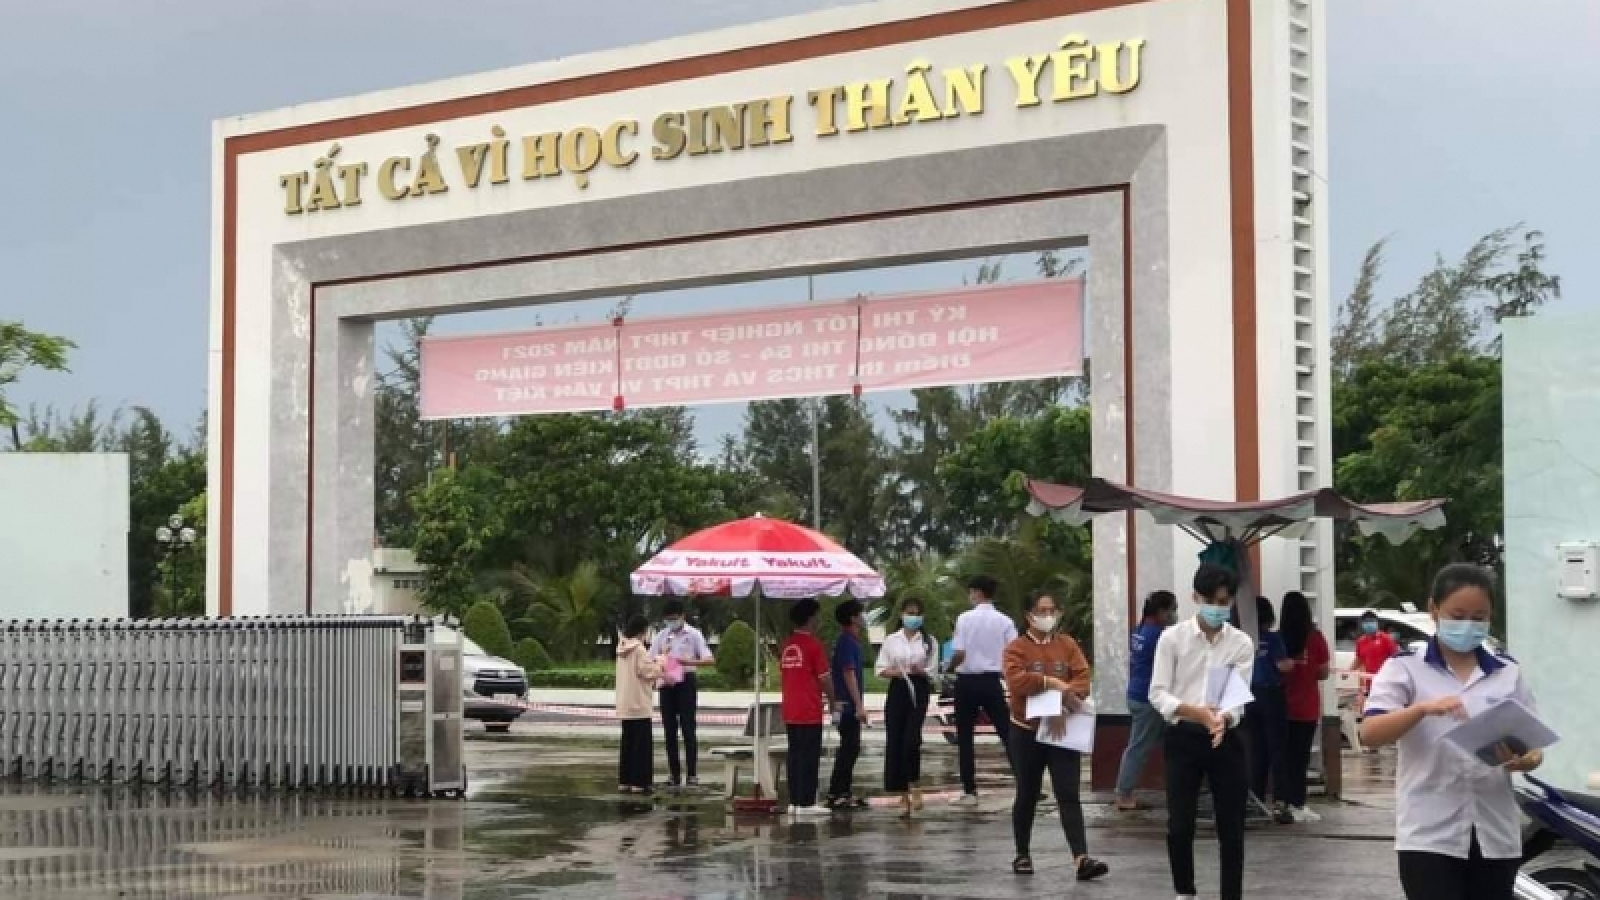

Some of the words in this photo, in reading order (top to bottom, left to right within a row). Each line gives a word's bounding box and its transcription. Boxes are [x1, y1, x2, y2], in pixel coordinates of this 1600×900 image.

[281, 143, 368, 215] TẤT
[378, 133, 448, 201] CẢ
[456, 124, 510, 188] VÌ
[522, 120, 640, 190] HỌC
[651, 95, 794, 160] SINH
[808, 58, 988, 136] THÂN
[1005, 32, 1146, 108] YÊU
[685, 556, 751, 569] Yakult
[762, 556, 832, 569] Yakult
